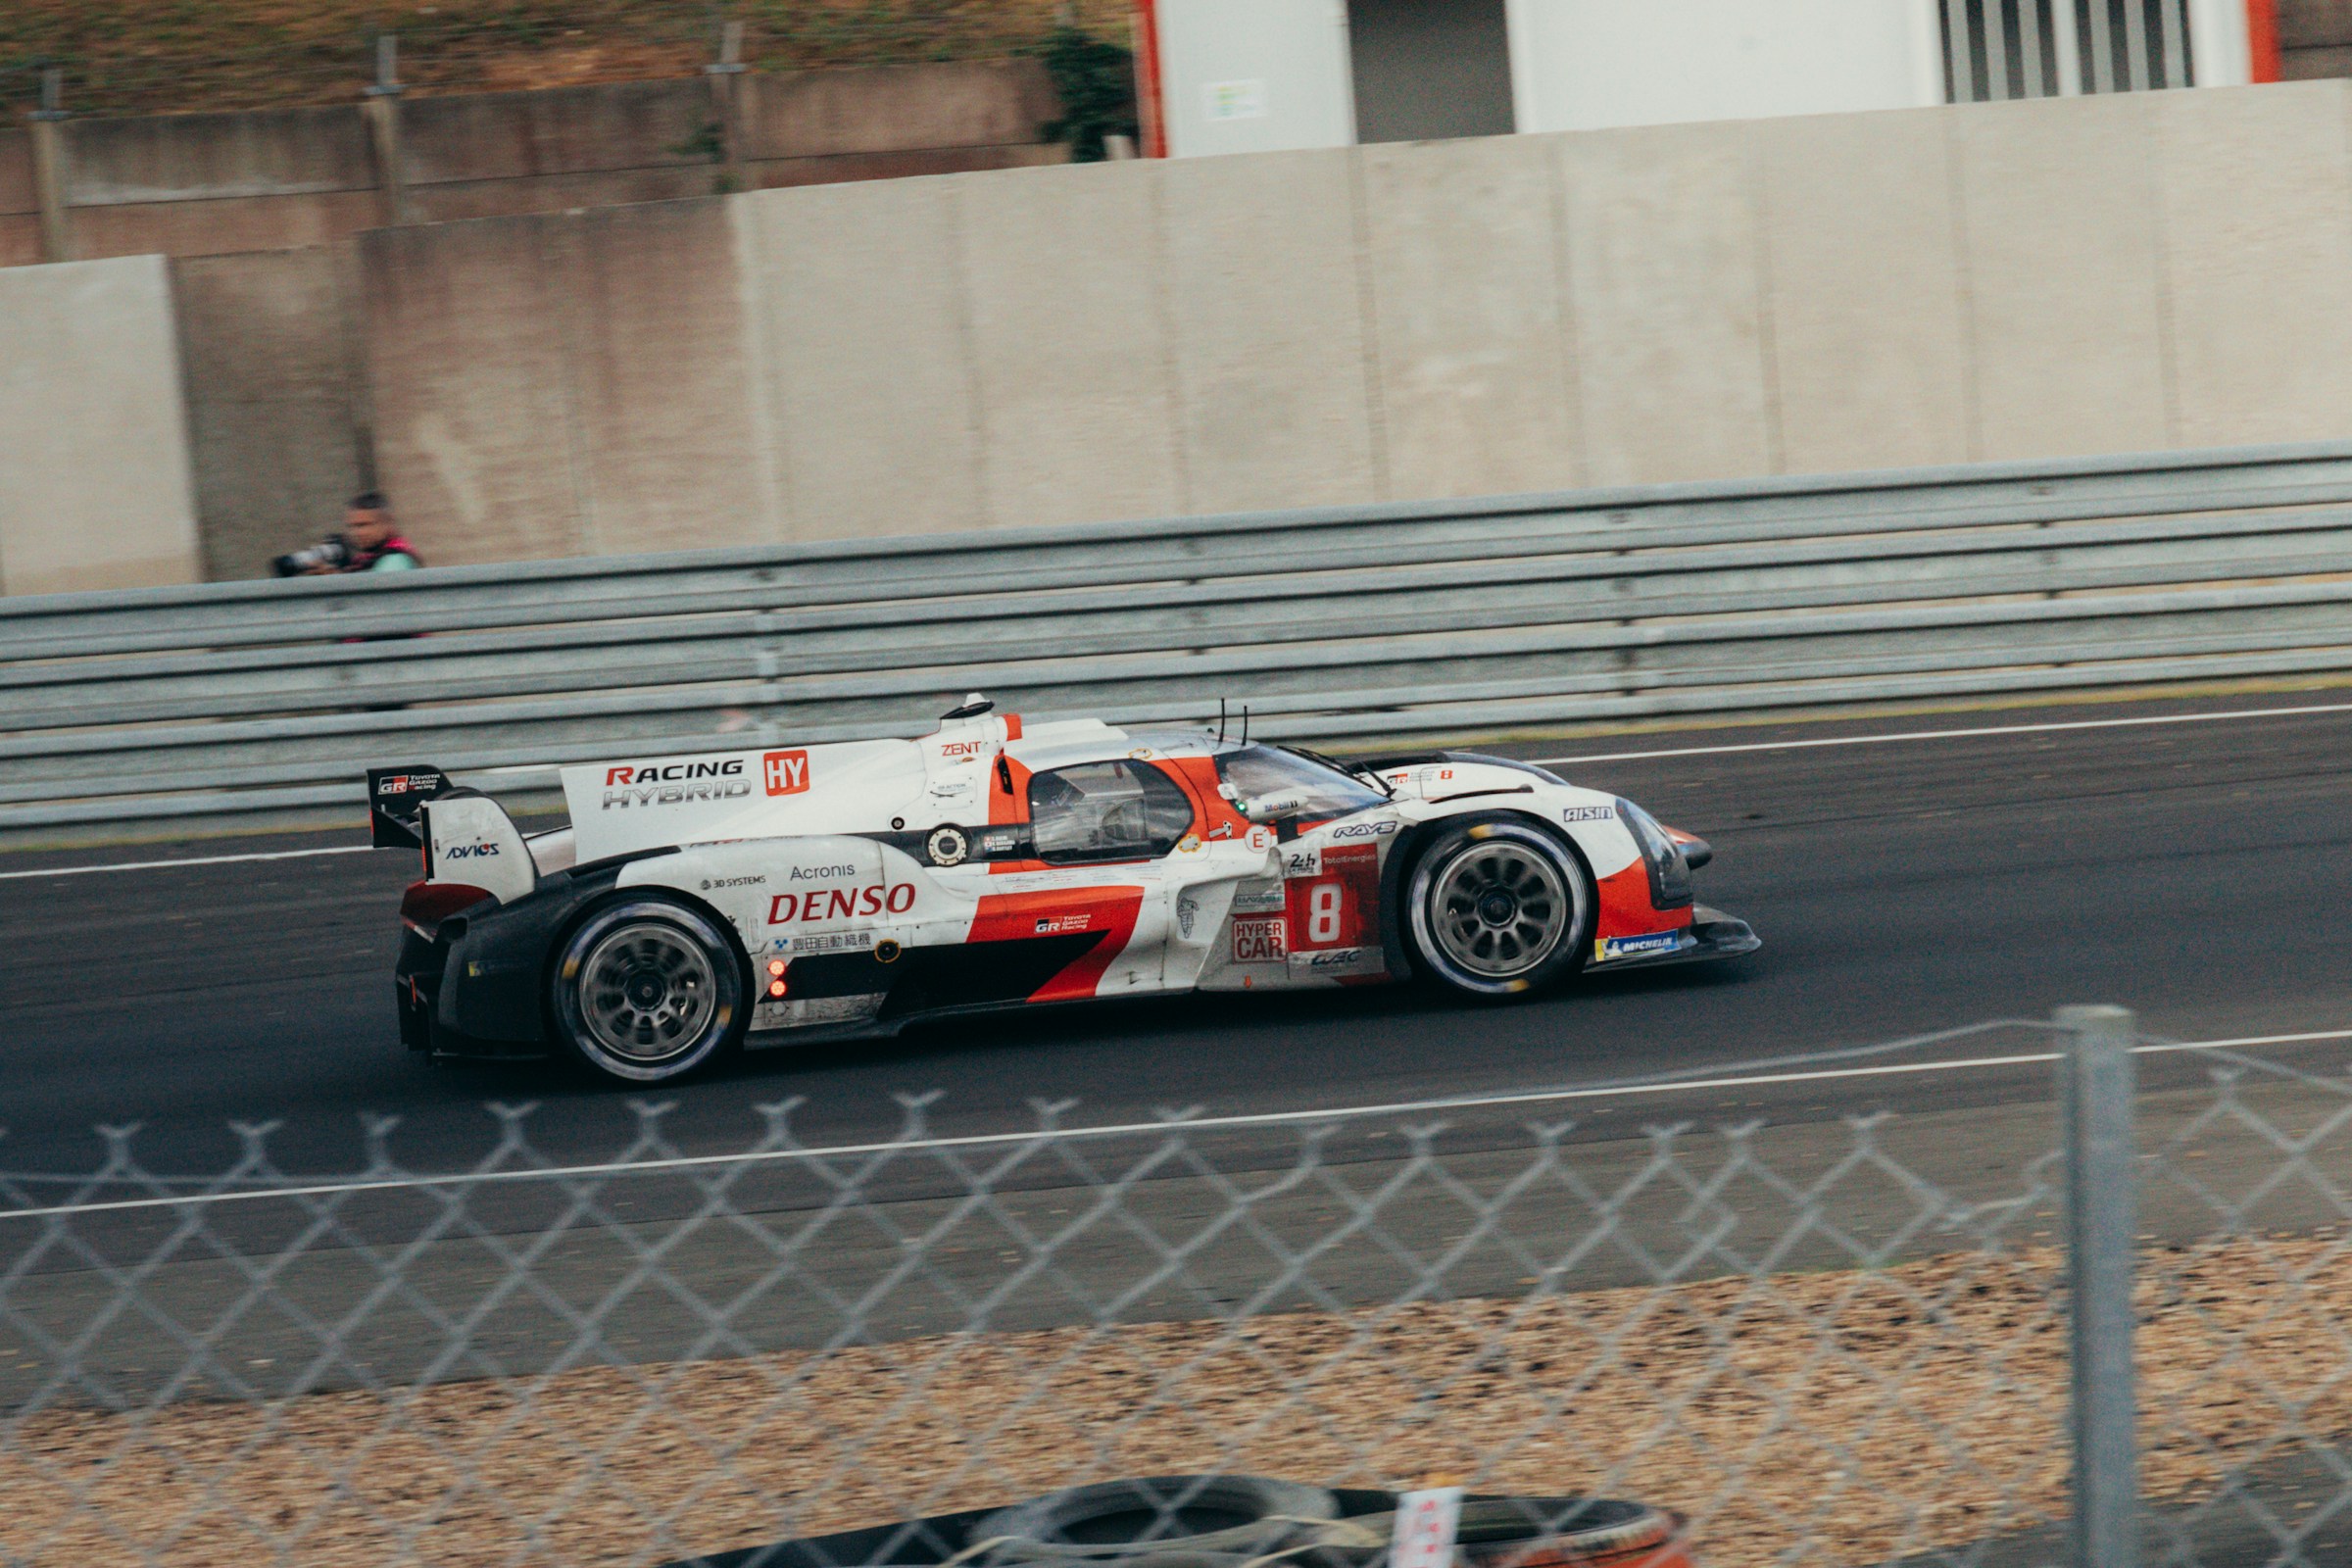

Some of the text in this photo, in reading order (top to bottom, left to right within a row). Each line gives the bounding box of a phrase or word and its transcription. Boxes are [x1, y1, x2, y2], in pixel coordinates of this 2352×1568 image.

[941, 741, 981, 757] ZENT
[606, 760, 744, 786] RACING
[766, 758, 805, 789] HY
[602, 779, 752, 810] HYBRID
[1264, 802, 1290, 812] Mobil
[1564, 808, 1613, 821] AISIN
[1333, 821, 1397, 838] RAYS
[1252, 833, 1264, 849] E
[1323, 853, 1376, 865] TotalEnergies
[790, 863, 856, 881] Acronis
[713, 875, 766, 889] 3D SYSTEMS
[767, 883, 916, 925] DENSO
[1308, 883, 1343, 943] 8
[1237, 922, 1282, 938] HYPER
[1237, 936, 1285, 959] CAR
[1623, 937, 1673, 953] MICHELIN
